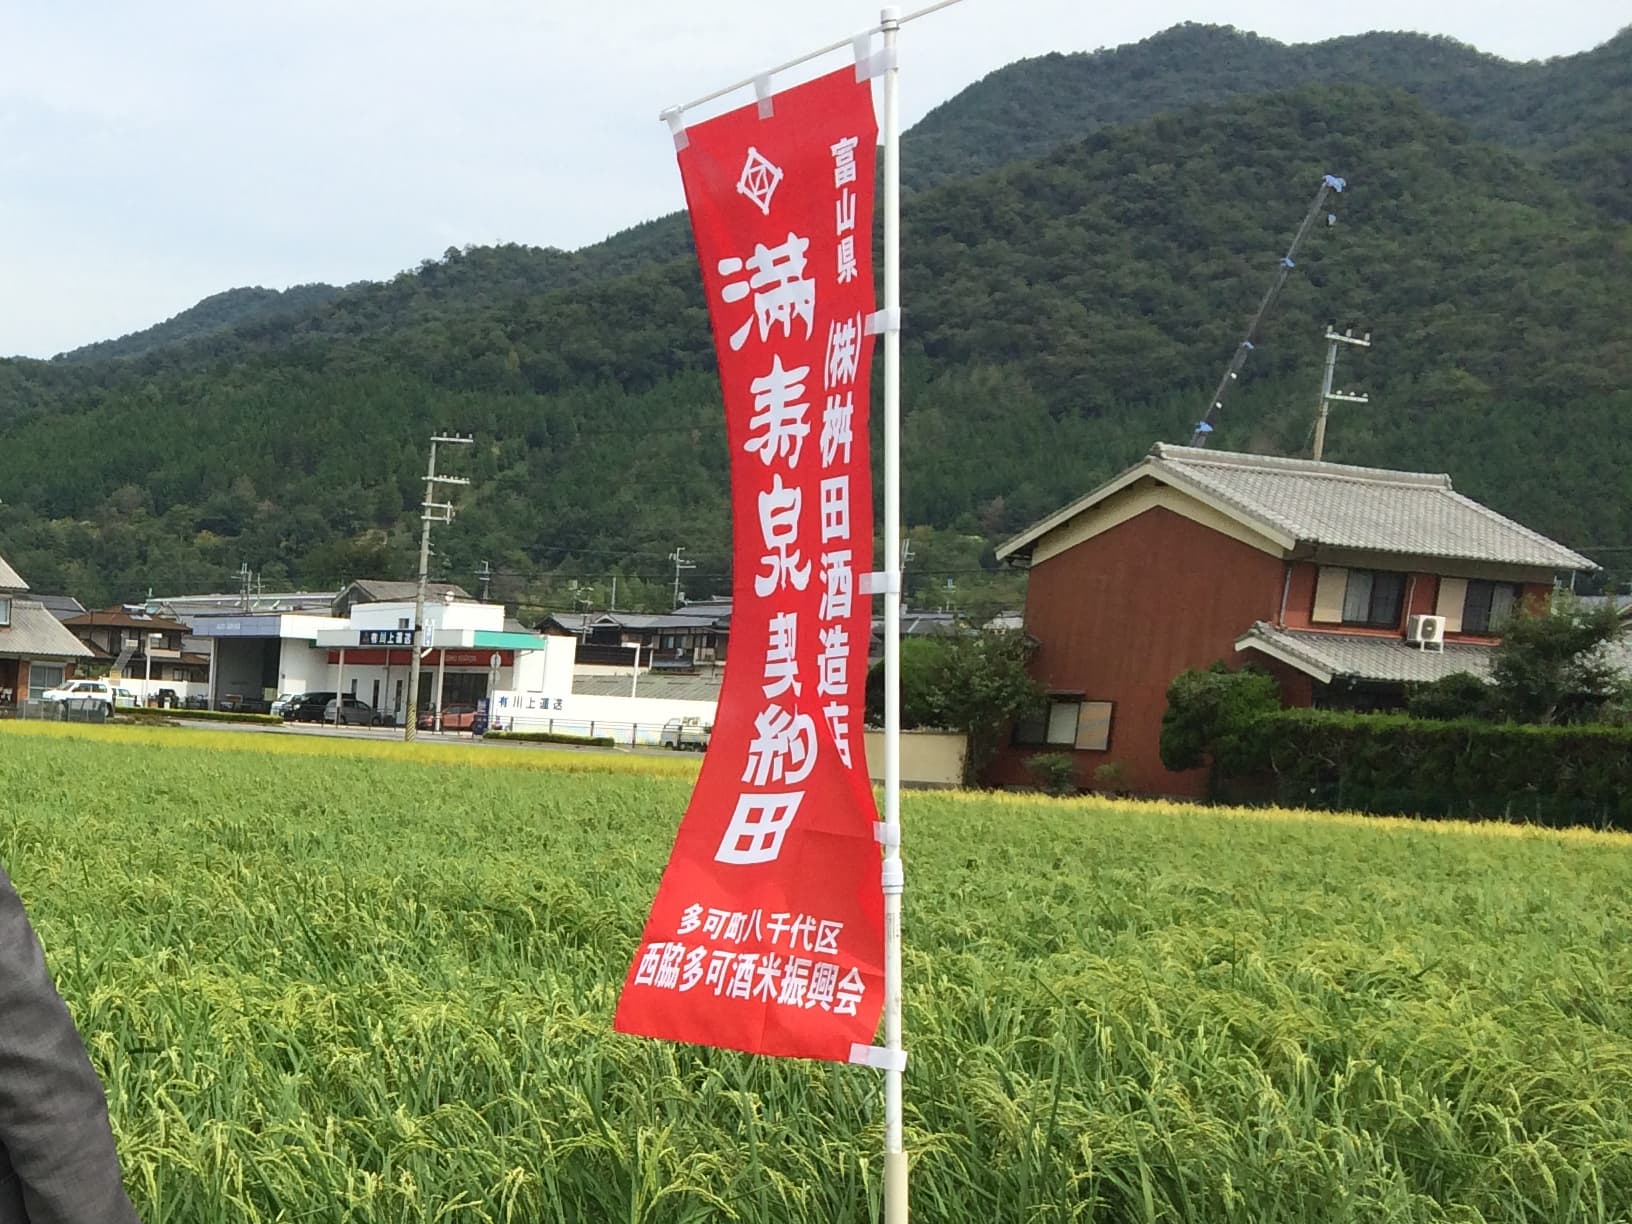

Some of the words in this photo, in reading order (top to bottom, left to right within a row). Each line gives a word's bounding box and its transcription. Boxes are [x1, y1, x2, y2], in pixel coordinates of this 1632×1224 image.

[829, 136, 859, 284] 富山県
[676, 903, 844, 955] 多可町八千代区
[633, 941, 866, 1016] 西脇多可酒米振興会
